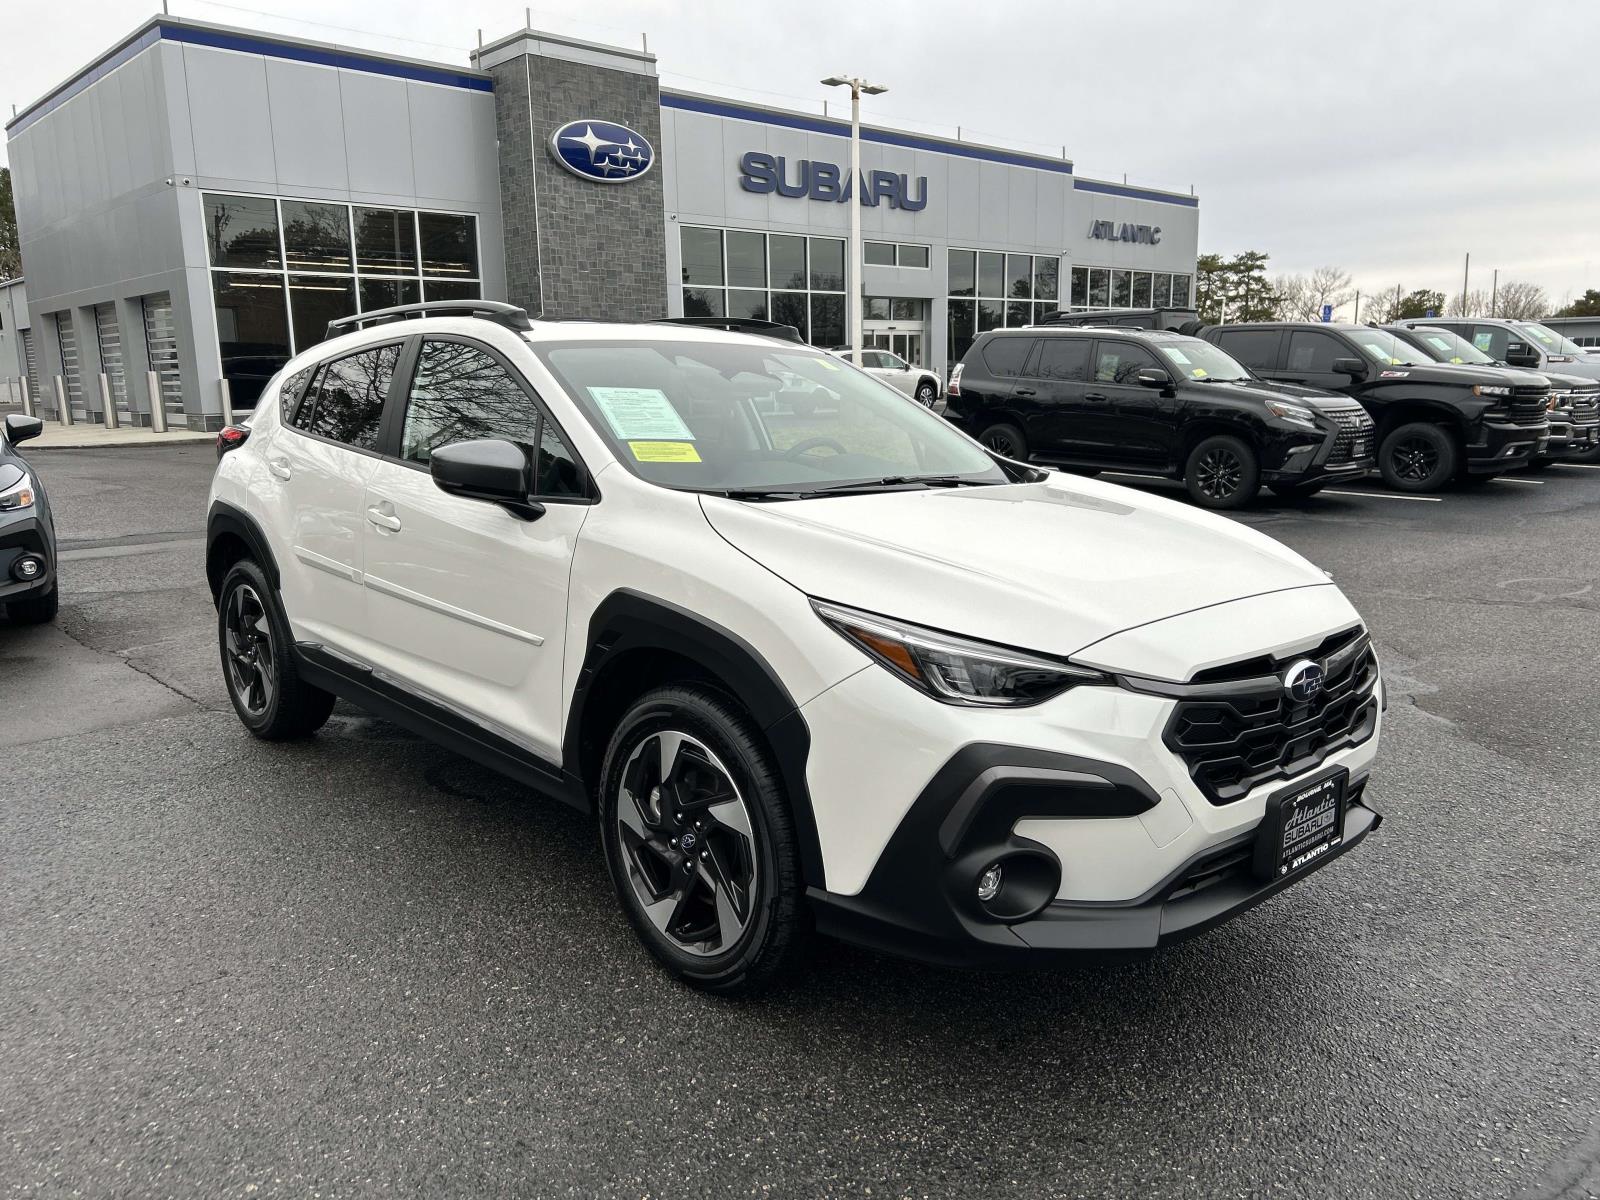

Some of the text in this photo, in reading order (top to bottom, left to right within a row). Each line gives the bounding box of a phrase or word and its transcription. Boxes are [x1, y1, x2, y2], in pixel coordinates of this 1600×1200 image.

[740, 152, 927, 211] SUBARU
[1088, 219, 1162, 245] ATLANTIC
[1285, 794, 1335, 831] Atlantic
[1284, 816, 1324, 846] SUBARU
[1292, 843, 1328, 868] ATLANTIC
